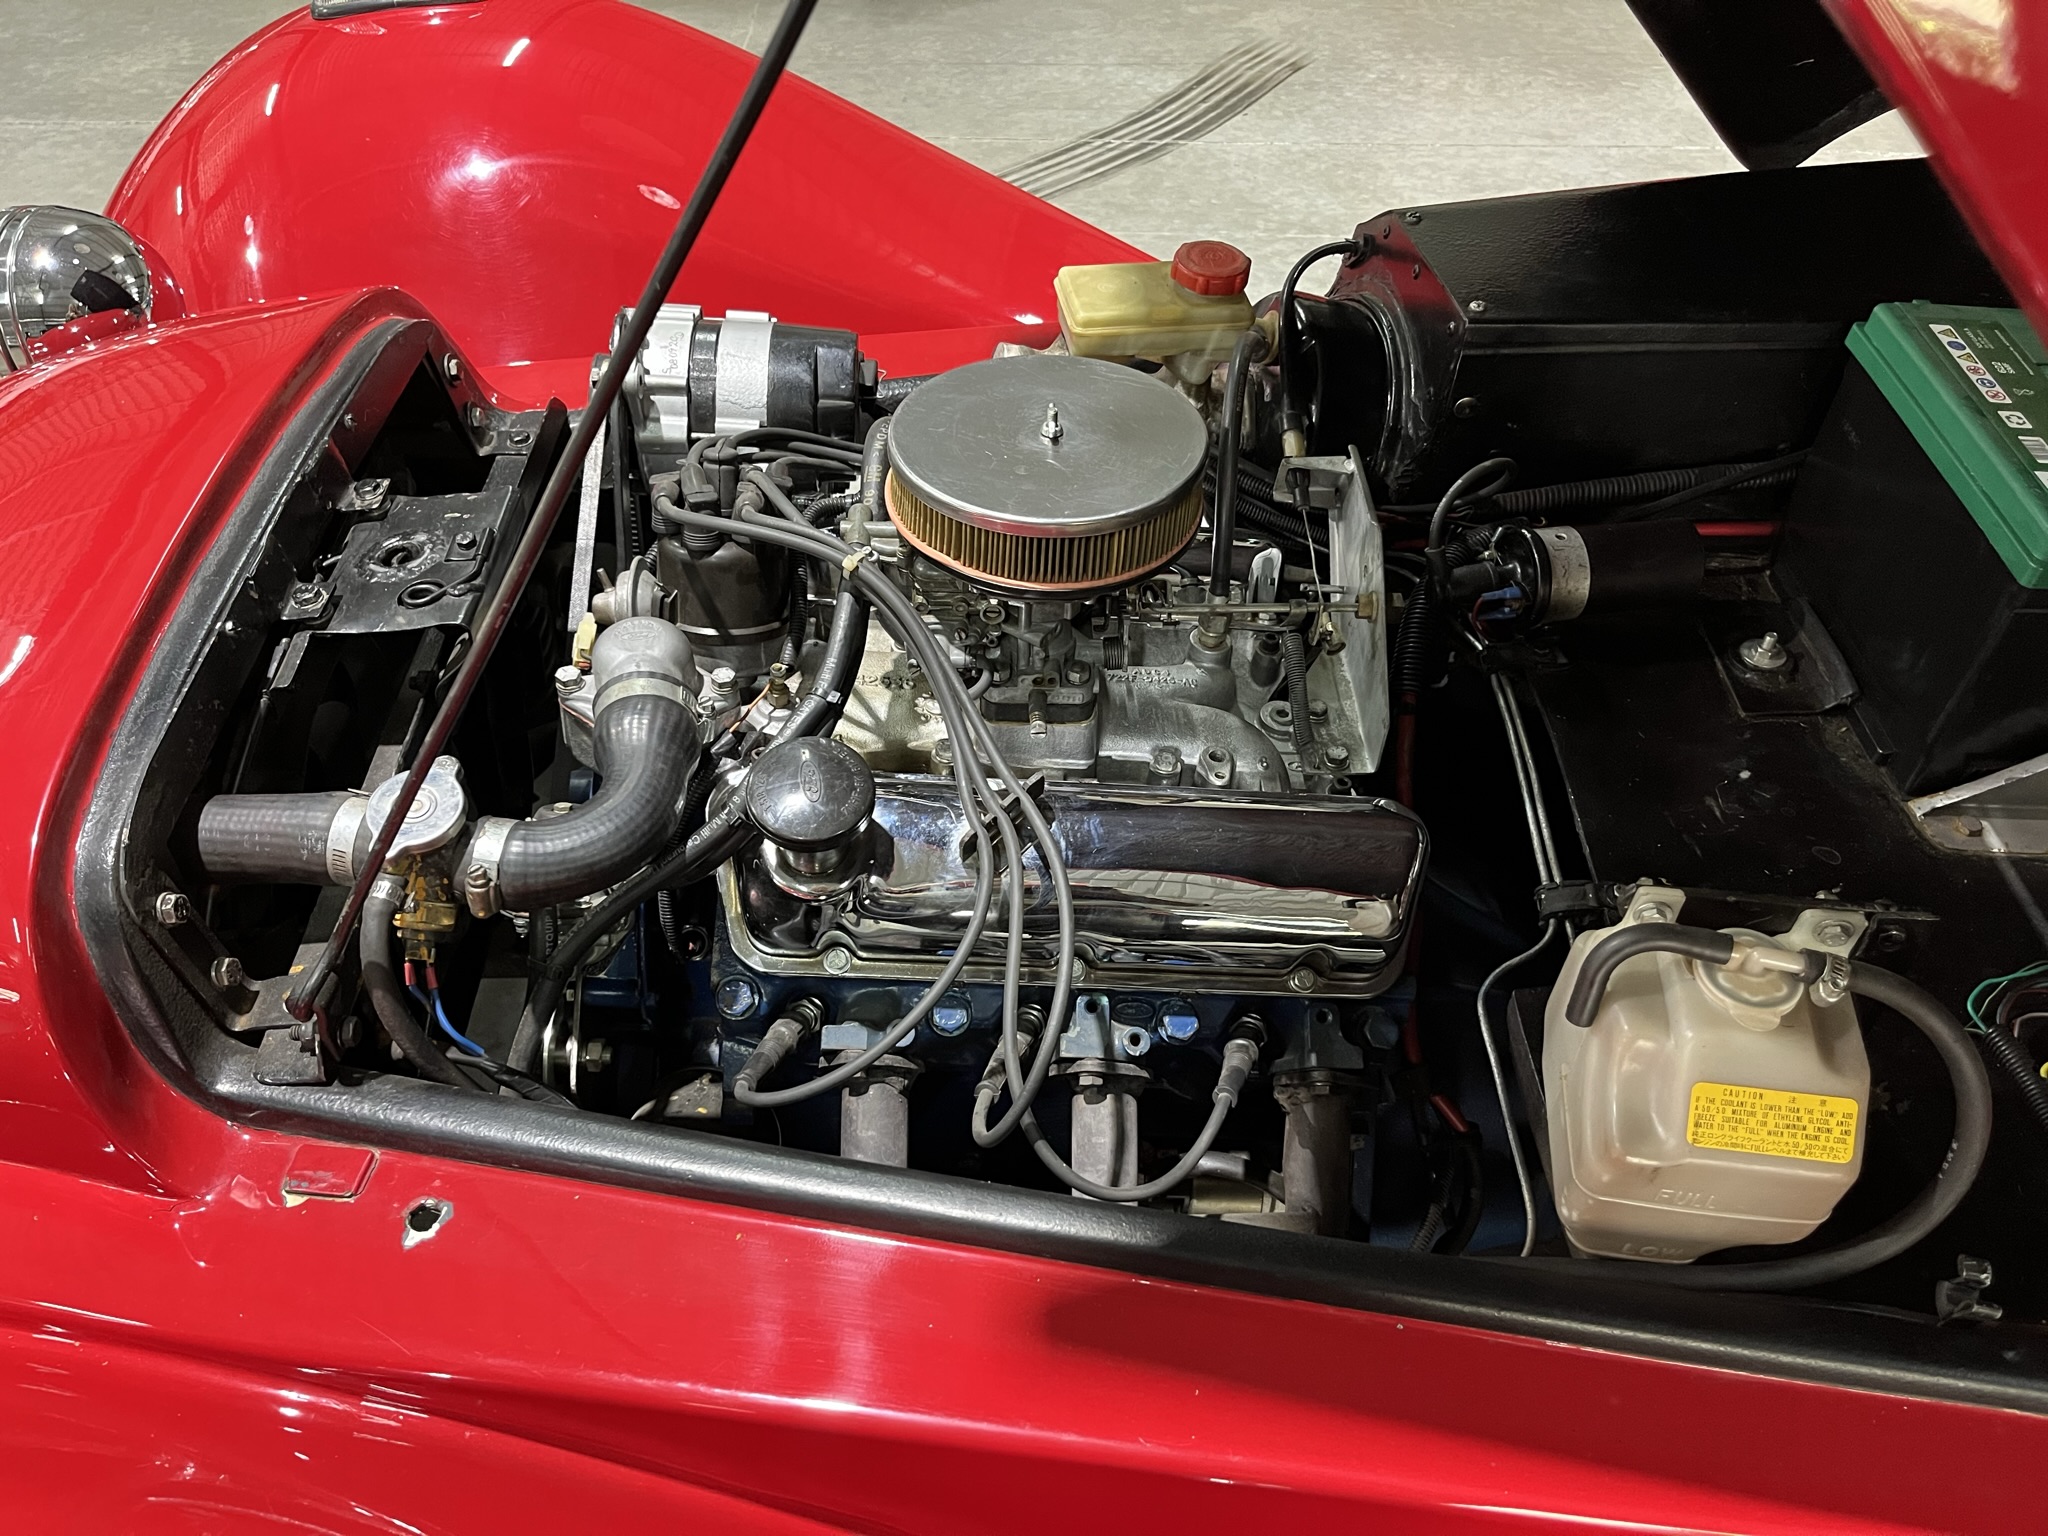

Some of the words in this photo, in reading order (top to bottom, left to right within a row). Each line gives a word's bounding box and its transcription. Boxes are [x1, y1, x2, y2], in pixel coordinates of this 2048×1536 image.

[1723, 1088, 1763, 1100] CAUTION
[1706, 1096, 1716, 1105] THE
[1720, 1098, 1748, 1108] COOLANT
[1760, 1103, 1782, 1112] LOWER
[1785, 1105, 1800, 1114] THAN
[1694, 1113, 1716, 1121] FREEZE
[1722, 1116, 1750, 1126] SUITABLE
[1774, 1122, 1807, 1131] ALUMINIUM
[1814, 1126, 1834, 1135] ENGINE
[1732, 1108, 1757, 1118] MIXTURE
[1773, 1112, 1804, 1122] ETHYLENE
[1808, 1117, 1830, 1126] GLYCOL
[1694, 1120, 1714, 1130] WATER
[1728, 1124, 1738, 1133] THE
[1767, 1130, 1784, 1138] WHEN
[1787, 1131, 1799, 1139] THE
[1801, 1133, 1821, 1142] ENGINE
[1654, 1188, 1716, 1209] FULL
[1621, 1242, 1684, 1256] LOW
